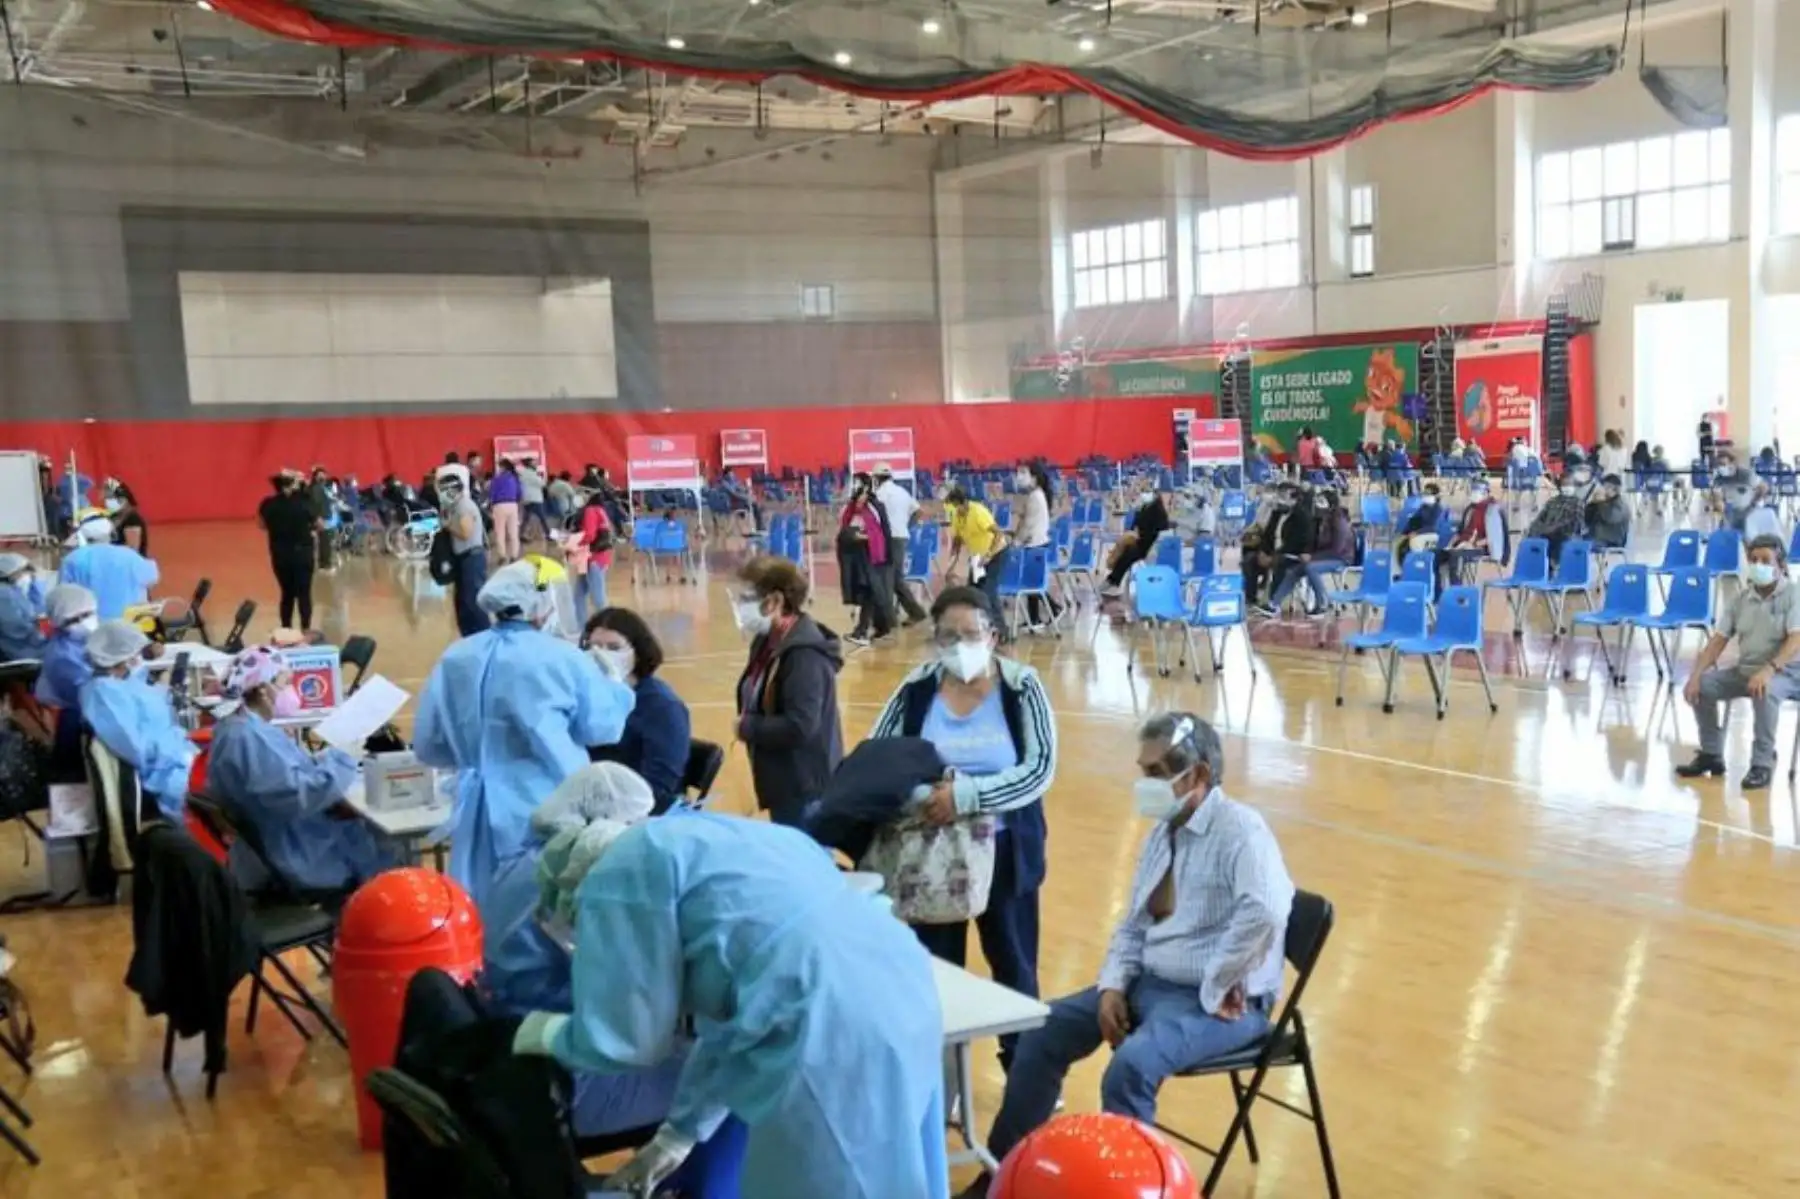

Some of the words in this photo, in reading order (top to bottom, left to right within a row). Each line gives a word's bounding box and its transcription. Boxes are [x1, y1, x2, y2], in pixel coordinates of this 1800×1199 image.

[1260, 373, 1284, 389] ESTA
[1285, 372, 1310, 388] SEDE
[1311, 369, 1353, 386] LEGADO
[1261, 390, 1273, 406] ES
[1274, 389, 1287, 405] DE
